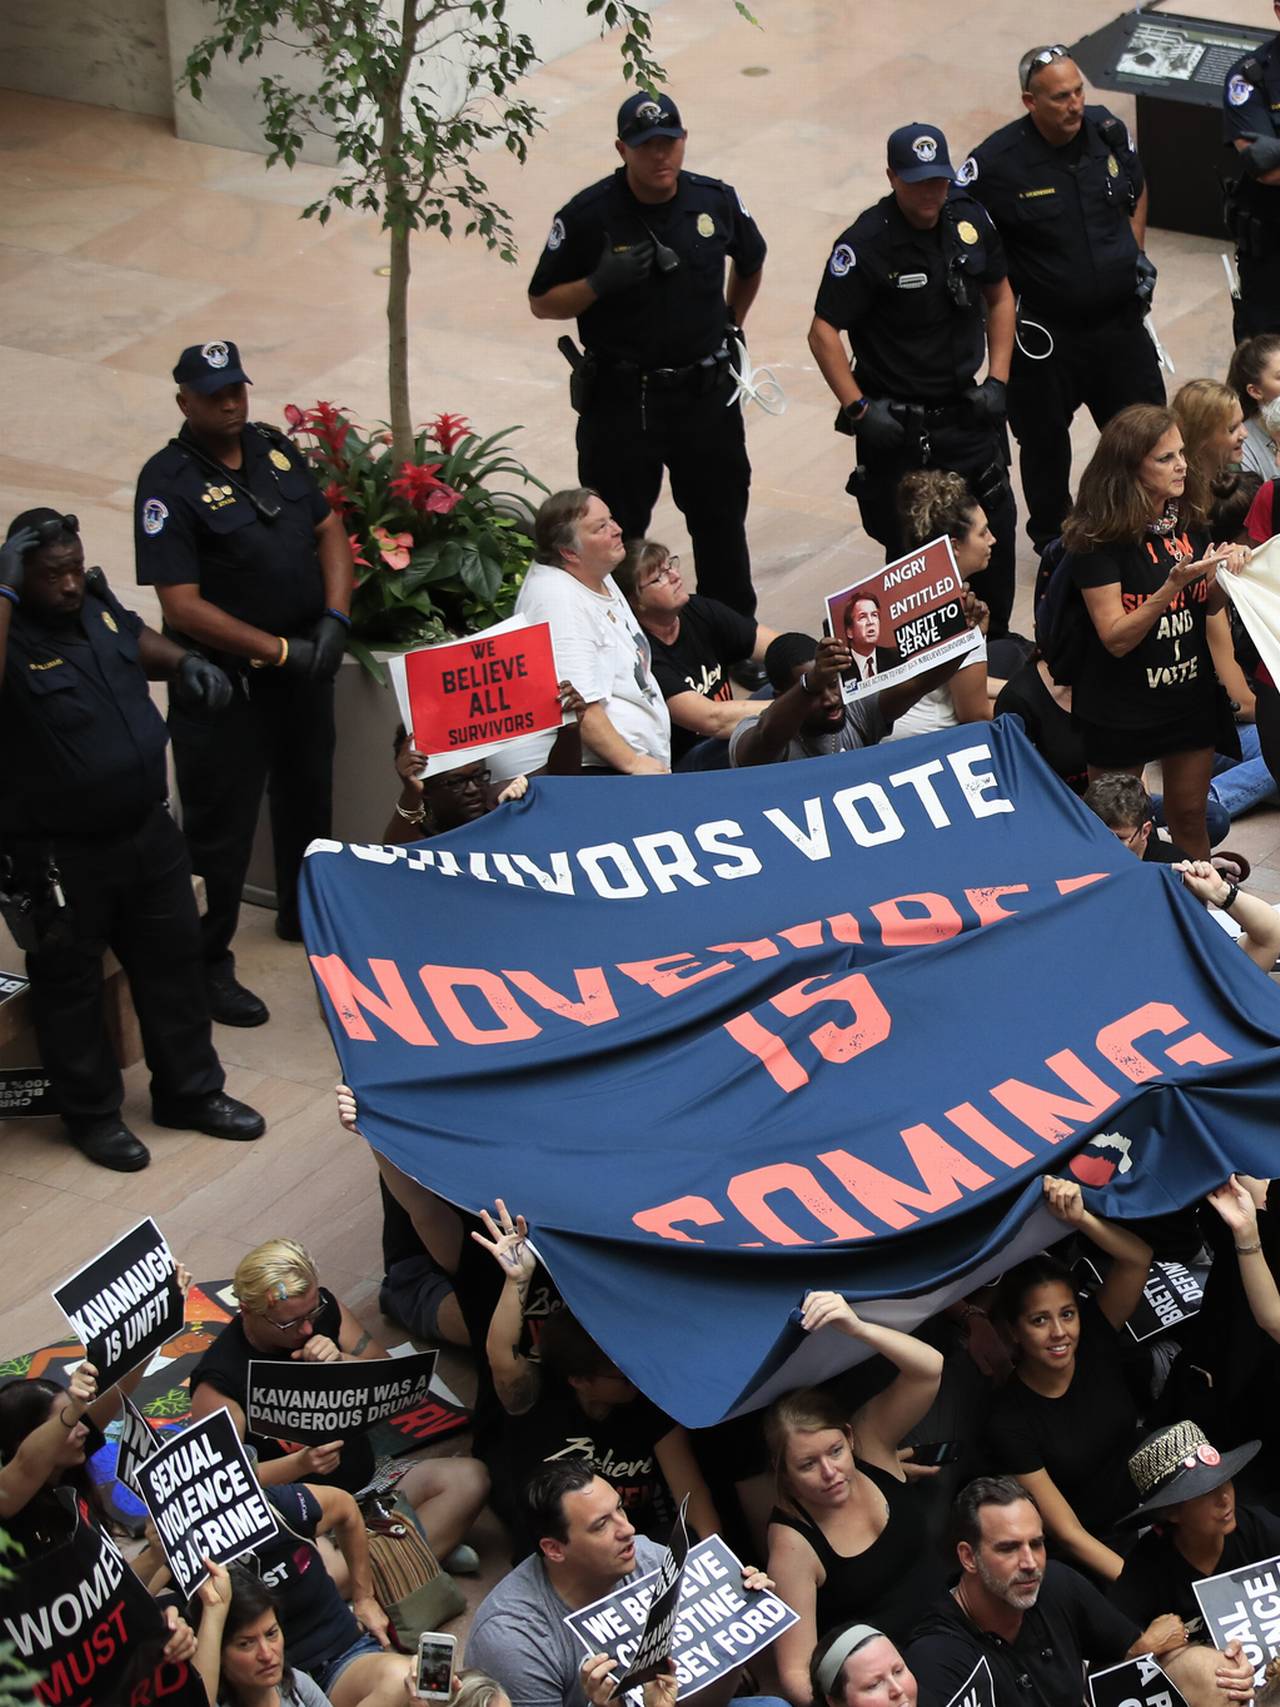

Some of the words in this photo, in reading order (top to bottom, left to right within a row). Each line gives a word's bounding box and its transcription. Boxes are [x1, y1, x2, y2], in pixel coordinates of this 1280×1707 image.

[883, 556, 927, 592] ANGRY
[1146, 542, 1158, 564] I
[889, 577, 954, 620] ENTITLED
[896, 611, 939, 643] UNFIT
[939, 603, 959, 624] TO
[900, 627, 942, 658] SERVE
[1156, 609, 1194, 640] AND
[471, 640, 496, 660] WE
[1174, 639, 1181, 661] I
[442, 654, 528, 694] BELIEVE
[1146, 655, 1198, 689] VOTE
[469, 686, 511, 718] ALL
[448, 712, 534, 746] SURVIVORS
[303, 819, 763, 900] IVORS
[764, 744, 1016, 861] VOTE
[725, 972, 893, 1094] IS
[632, 1002, 1234, 1248] COMING
[70, 1241, 176, 1344] KAVANAUGH
[105, 1329, 122, 1367] IS
[124, 1287, 169, 1350] UNFIT
[252, 1387, 369, 1409] KAVANAUGH
[373, 1378, 412, 1402] WAS
[415, 1375, 426, 1389] A
[250, 1405, 363, 1431] DANGEROUS
[150, 1433, 223, 1505] SEXUAL
[543, 1436, 653, 1478] Blieve
[157, 1459, 250, 1547] VIOLENCE
[171, 1550, 191, 1588] IS
[185, 1540, 203, 1575] A
[195, 1494, 271, 1563] CRIME
[3, 1524, 125, 1657] WOMEN
[262, 1562, 290, 1588] ST
[582, 1607, 631, 1645] WE
[621, 1550, 729, 1626] BEEVE
[616, 1583, 747, 1668] CSTINE
[712, 1597, 787, 1657] FORD
[1218, 1601, 1267, 1687] UAL
[32, 1601, 128, 1707] MUST
